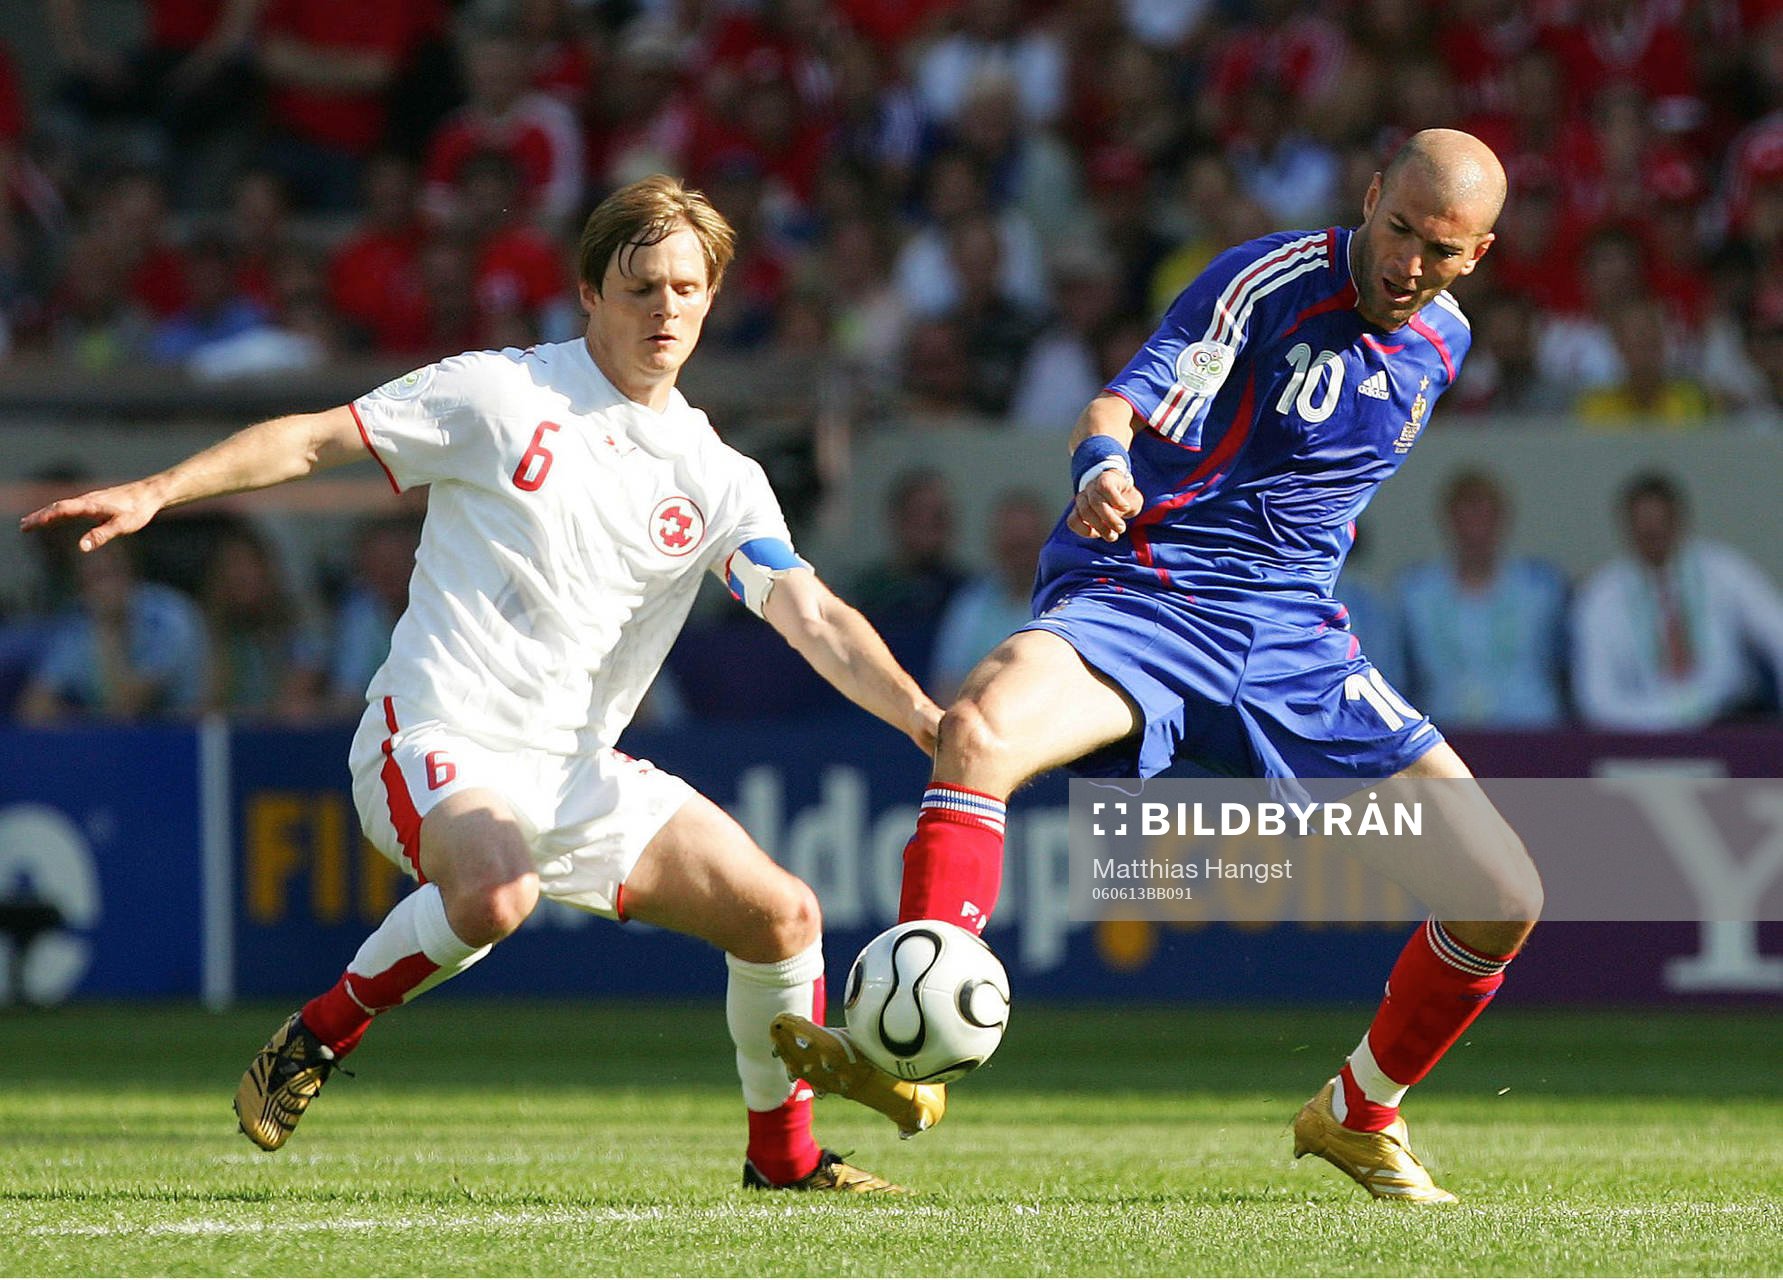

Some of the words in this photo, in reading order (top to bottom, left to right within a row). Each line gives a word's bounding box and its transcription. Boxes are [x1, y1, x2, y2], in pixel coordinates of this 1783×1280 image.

[1275, 342, 1346, 423] 10
[512, 420, 562, 492] 6
[425, 750, 457, 791] 6
